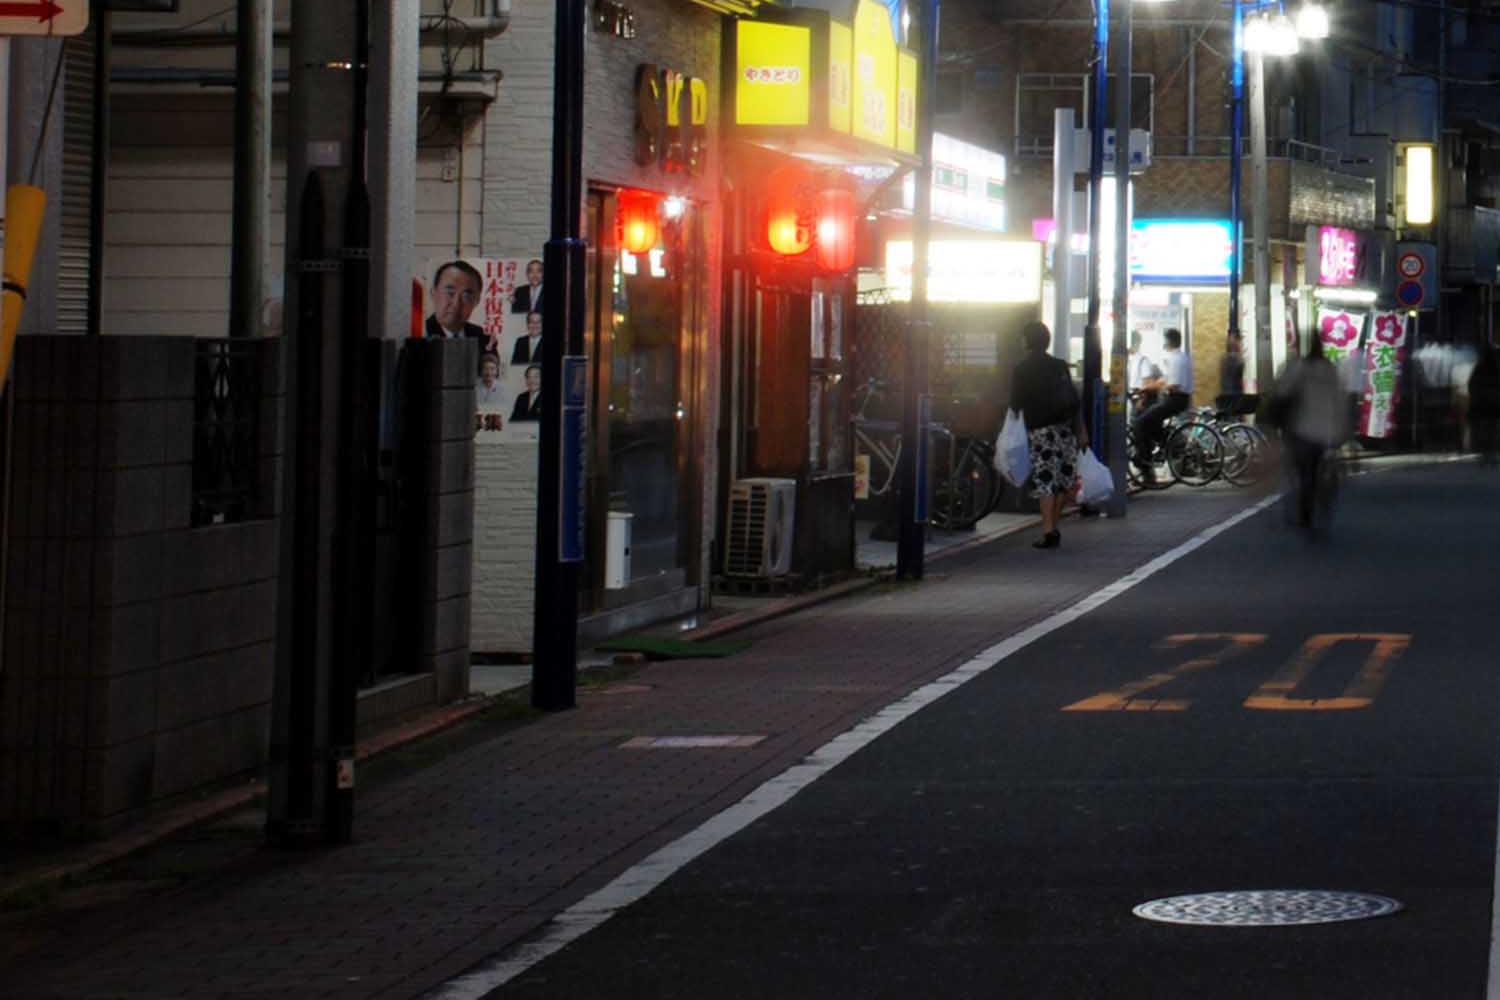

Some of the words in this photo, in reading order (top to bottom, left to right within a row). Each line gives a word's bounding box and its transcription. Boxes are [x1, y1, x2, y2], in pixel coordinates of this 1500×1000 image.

[744, 65, 802, 83] やきとり
[1061, 632, 1413, 711] 20
